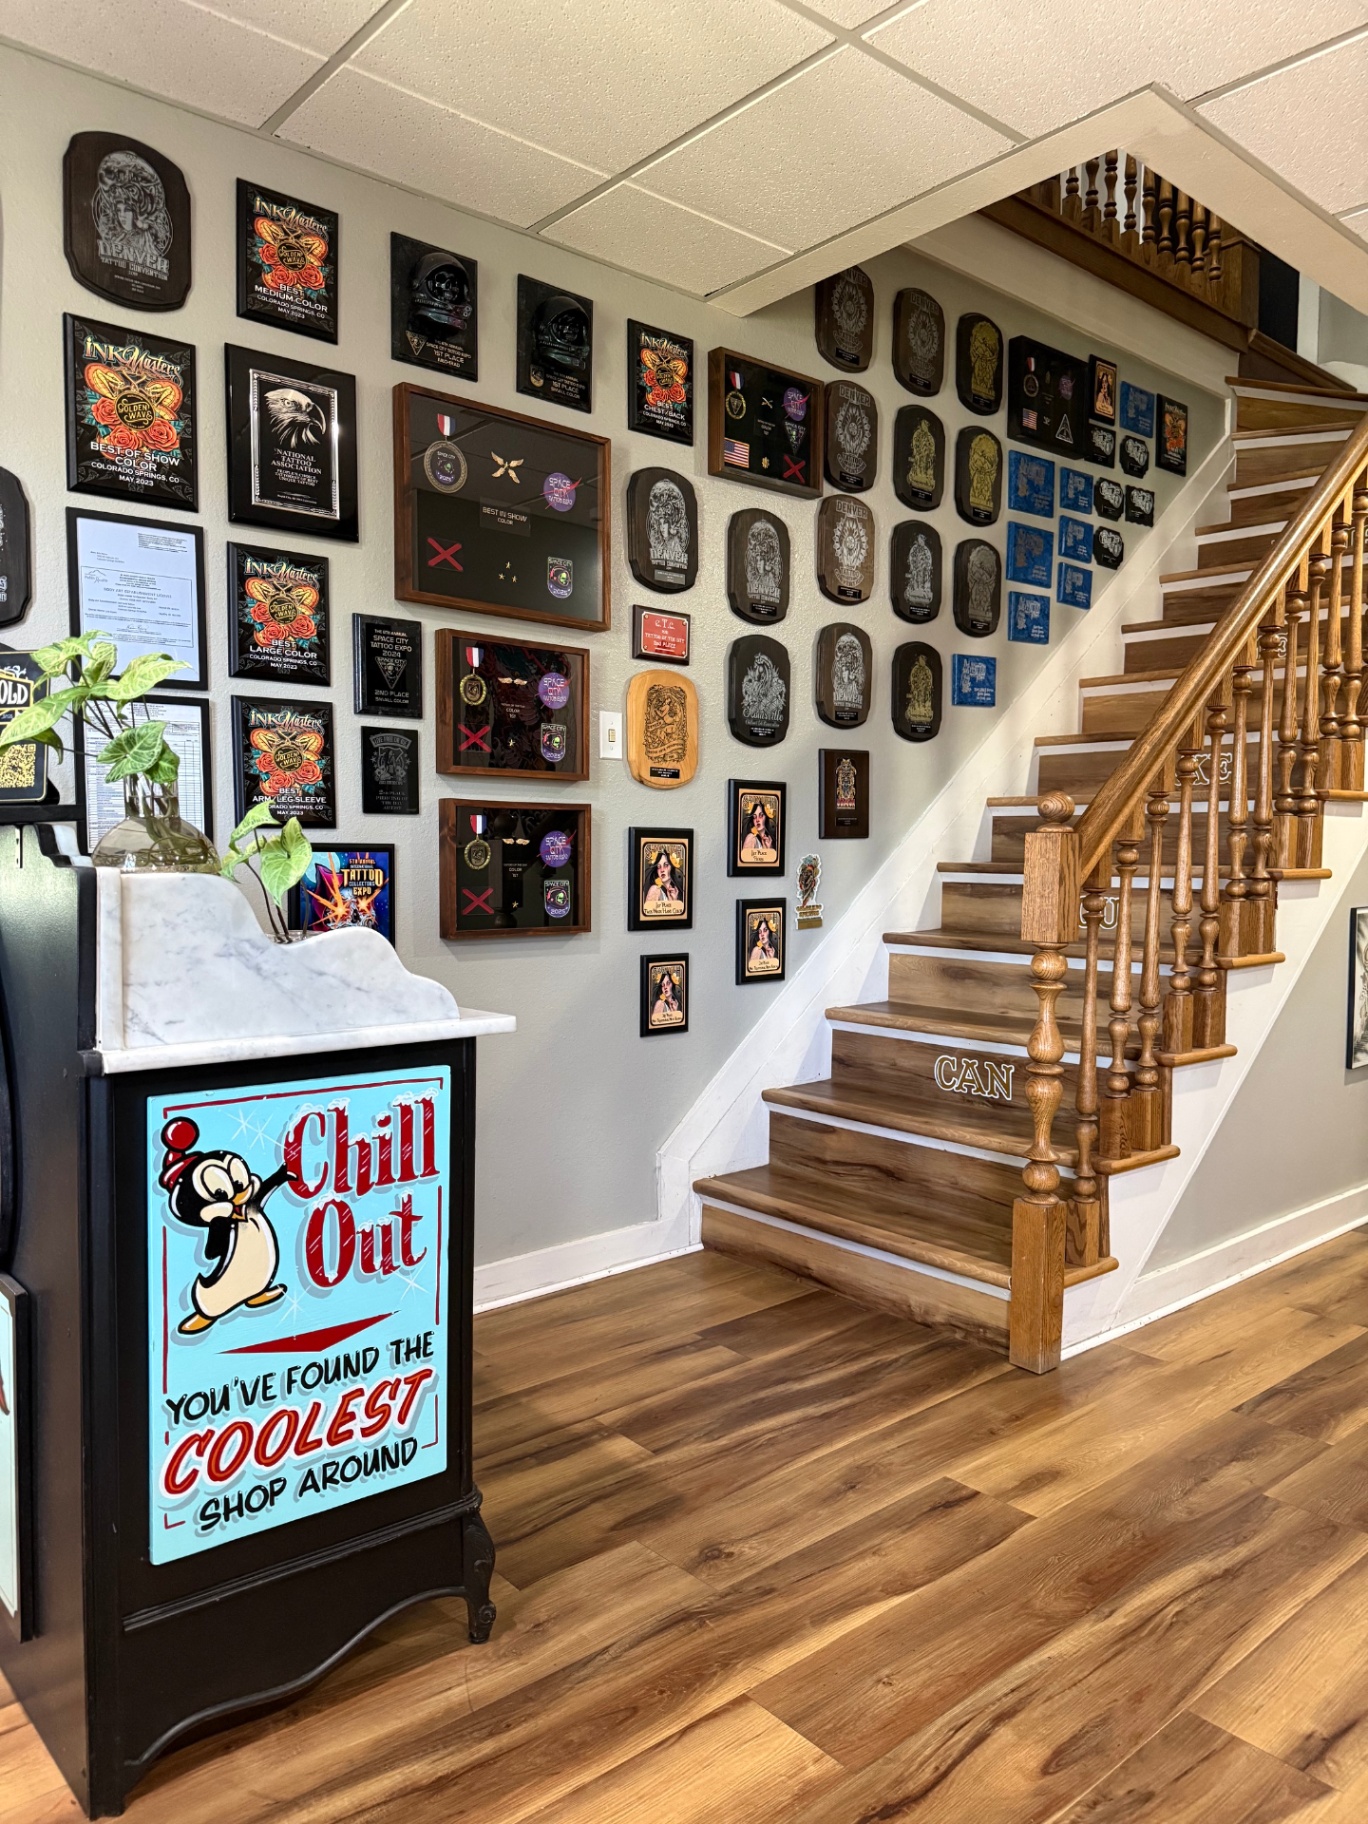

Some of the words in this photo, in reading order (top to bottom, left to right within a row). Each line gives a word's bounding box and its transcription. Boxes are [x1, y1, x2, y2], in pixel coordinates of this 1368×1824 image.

[97, 239, 169, 275] DENVER
[280, 284, 304, 296] BEST
[254, 284, 294, 302] MEDIUM
[296, 297, 328, 312] COLOR
[257, 294, 290, 308] COLORADO
[122, 345, 182, 384] Masters
[444, 352, 464, 363] PLACE
[840, 385, 870, 407] DENVER
[118, 398, 148, 414] GOLDEN
[124, 411, 152, 426] WAVE
[90, 442, 122, 455] BEST
[125, 448, 141, 458] OF
[144, 454, 180, 466] SHOW
[276, 448, 316, 462] NATIONAL
[281, 456, 312, 466] TATTOO
[91, 462, 133, 474] COLORADO
[115, 457, 156, 472] COLOR
[271, 460, 322, 474] ASSOCIATION
[136, 478, 154, 486] 2023
[549, 478, 570, 488] SPACE
[482, 506, 498, 516] BEST
[508, 512, 528, 522] SHOW
[836, 500, 868, 518] DENVER
[498, 517, 514, 525] COLOR
[650, 548, 688, 564] DENVER
[272, 640, 296, 648] BEST
[373, 635, 394, 643] SPACE
[250, 646, 282, 655] LARGE
[285, 650, 317, 658] COLOR
[370, 642, 394, 650] TATTOO
[394, 644, 412, 652] EXPO
[544, 678, 565, 687] SPACE
[546, 836, 566, 846] SPACE
[341, 869, 384, 887] TATTOO
[353, 886, 372, 896] EXPO
[934, 1055, 1014, 1100] CAN
[285, 1089, 439, 1198] Chill
[305, 1191, 427, 1287] Out
[166, 1373, 276, 1425] YOU'VE
[288, 1345, 379, 1391] FOUND
[390, 1331, 434, 1364] THE
[163, 1369, 433, 1494] COOLEST
[200, 1478, 287, 1531] SHOP
[299, 1437, 418, 1497] AROUND
